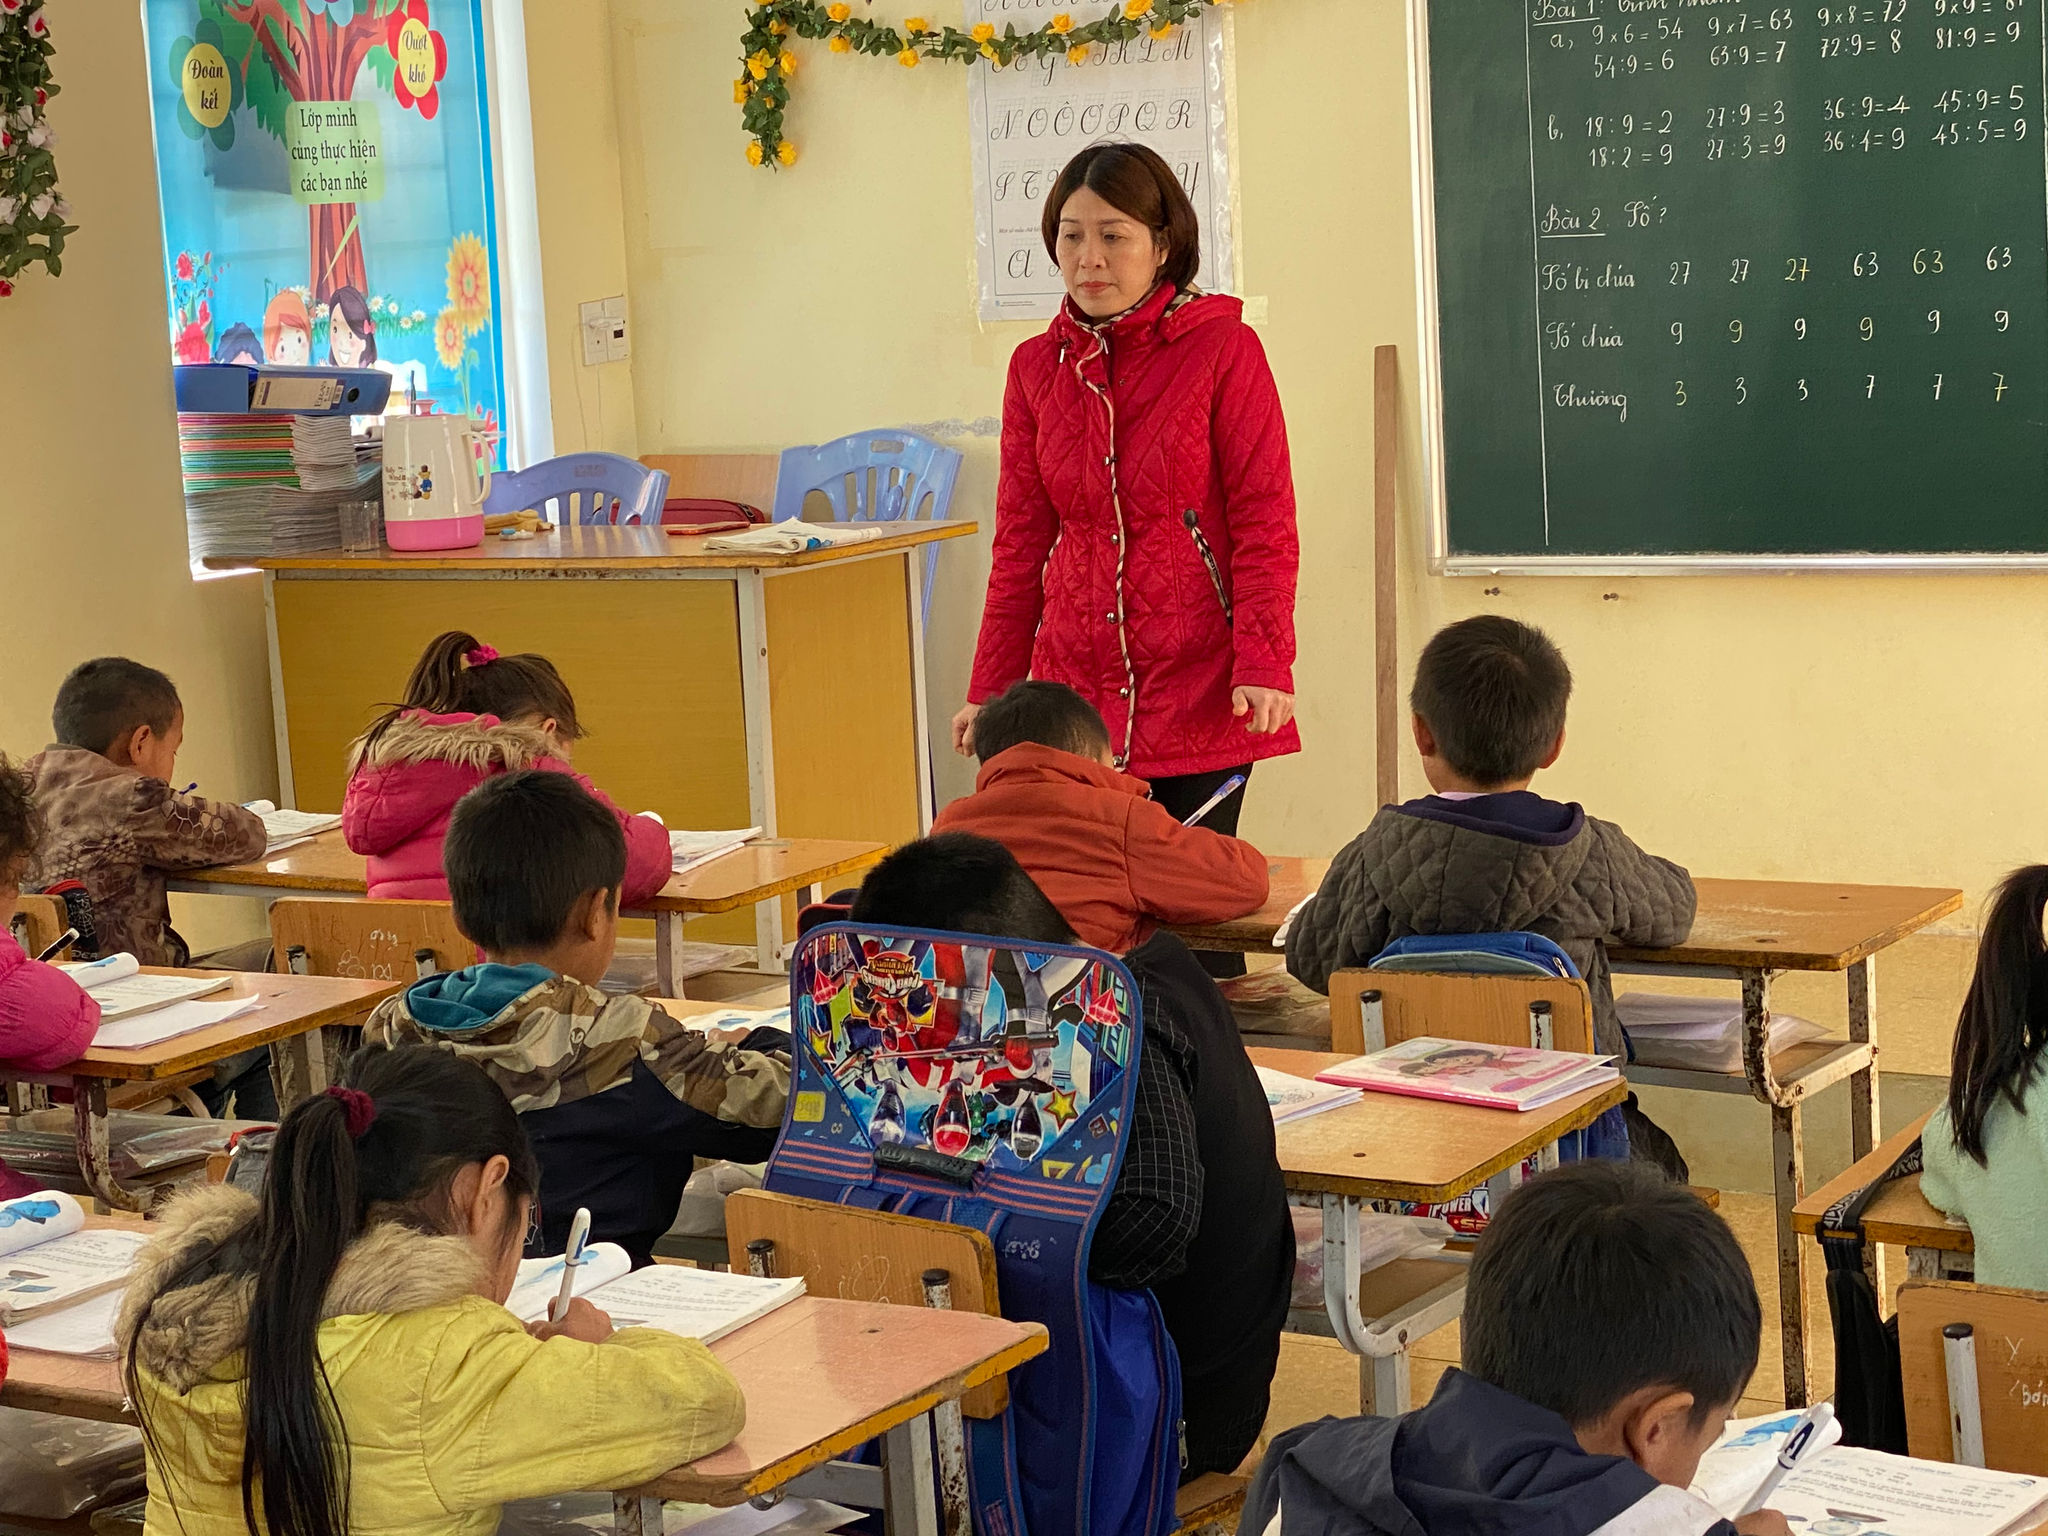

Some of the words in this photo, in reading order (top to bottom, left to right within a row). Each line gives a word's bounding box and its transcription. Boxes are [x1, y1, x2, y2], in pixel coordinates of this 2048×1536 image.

[402, 30, 428, 56] Vượt
[1162, 30, 1195, 63] M
[188, 58, 224, 80] Đoàn
[408, 63, 426, 83] khó
[201, 87, 218, 110] kết
[300, 108, 322, 133] Lớp
[326, 106, 357, 127] mình
[991, 109, 1024, 140] N
[1027, 107, 1049, 138] O
[1053, 101, 1075, 136] Ô
[1080, 103, 1105, 135] Ơ
[1106, 103, 1130, 134] P
[1135, 100, 1159, 132] Q
[1165, 99, 1196, 130] R
[291, 140, 319, 166] cùng
[321, 139, 346, 165] thực
[349, 138, 377, 164] hiện
[300, 172, 317, 192] các
[320, 172, 342, 197] bạn
[345, 170, 368, 190] nhé
[1540, 203, 1581, 233] Bài
[1541, 262, 1571, 291] Số
[1669, 261, 1691, 286] 27
[1729, 258, 1750, 285] 27
[1784, 257, 1811, 282] 27
[1853, 251, 1879, 277] 63
[1913, 248, 1944, 275] 63
[1986, 246, 2012, 271] 63
[1545, 320, 1576, 350] Số
[1670, 321, 1683, 345] 9
[1729, 319, 1743, 343] 9
[1794, 317, 1807, 340] 9
[1859, 316, 1873, 341] 9
[1927, 309, 1941, 334] 9
[1994, 310, 2009, 332] 9
[1553, 383, 1627, 423] Thương
[1675, 380, 1687, 406] 3
[1735, 376, 1748, 405] 3
[1797, 378, 1809, 401] 3
[1866, 374, 1875, 399] 7
[1932, 373, 1943, 400] 7
[1992, 372, 2009, 402] 7
